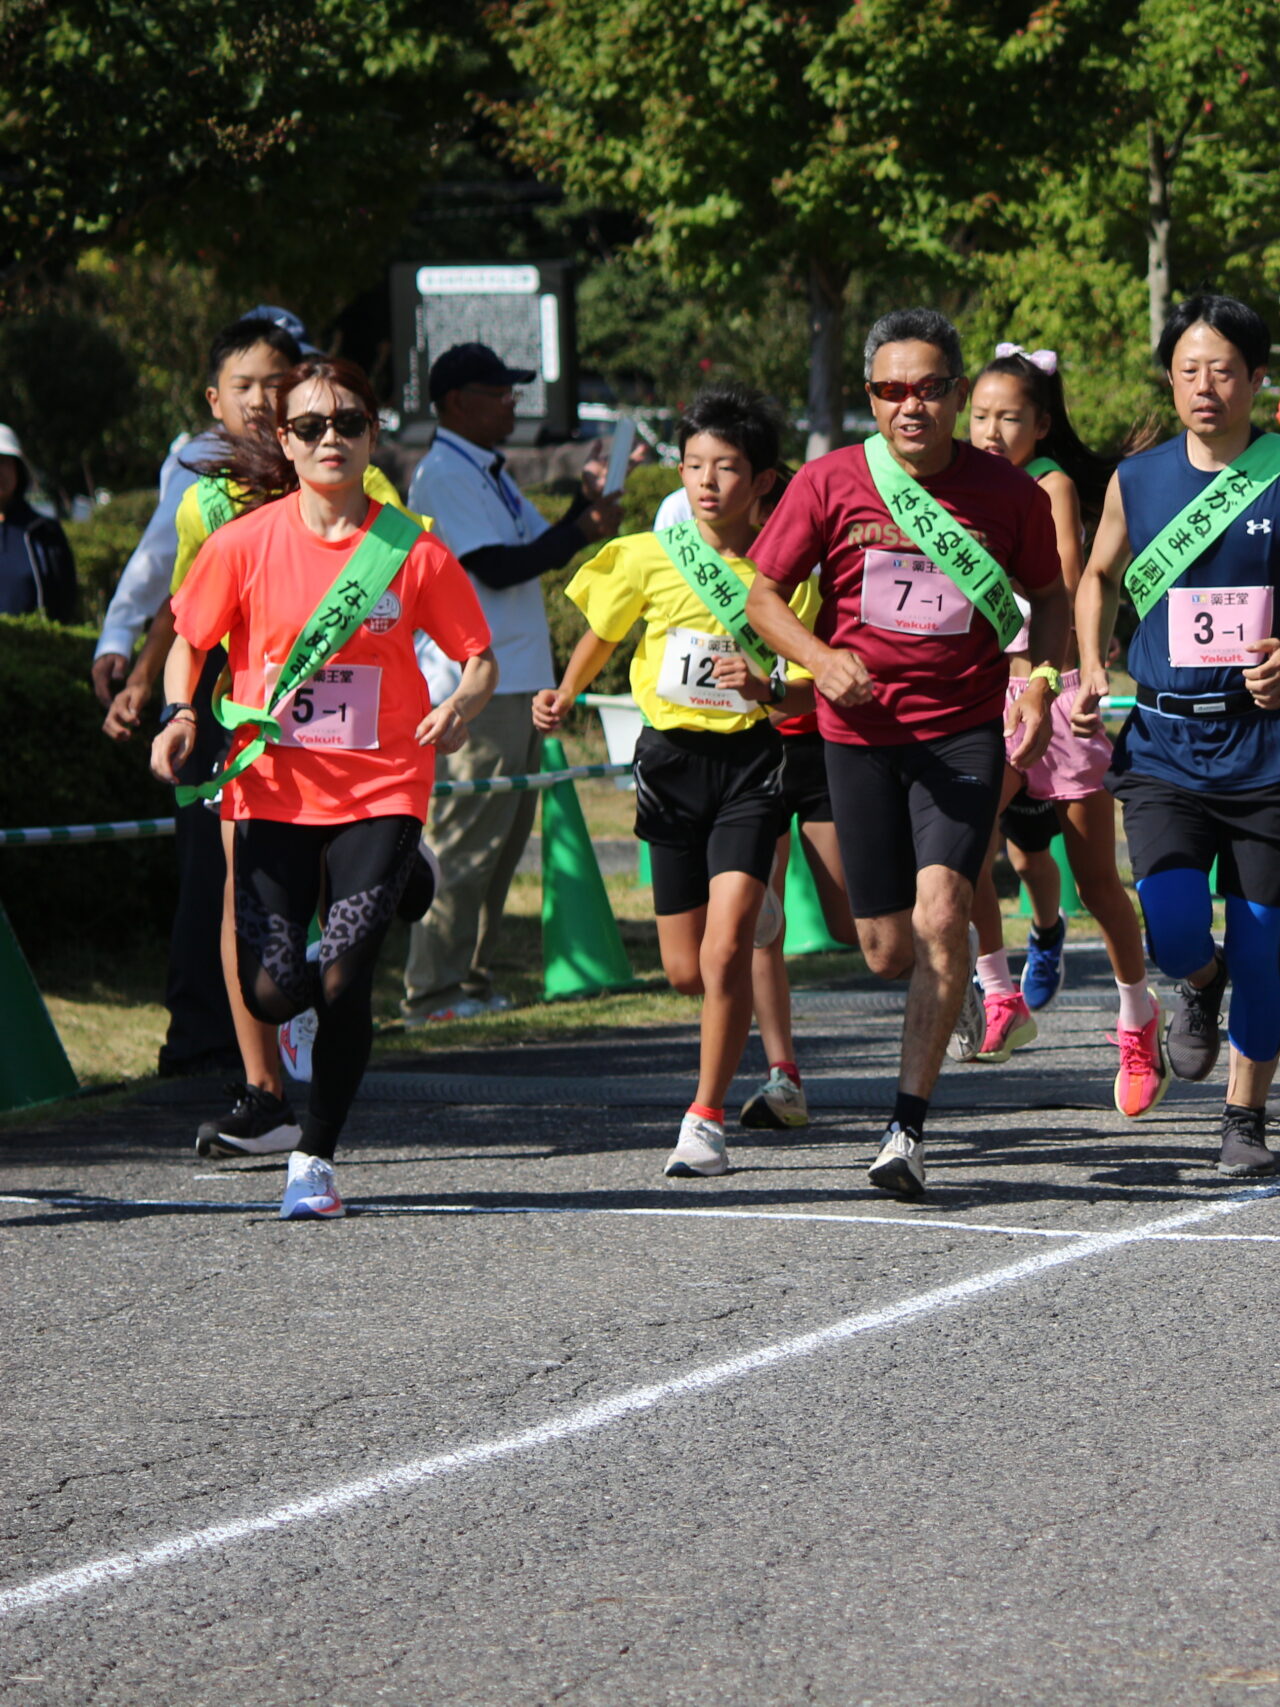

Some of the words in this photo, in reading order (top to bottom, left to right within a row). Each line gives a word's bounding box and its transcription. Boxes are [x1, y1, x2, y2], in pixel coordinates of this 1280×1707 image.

[1210, 592, 1249, 606] 薬王堂
[895, 619, 940, 631] Yakult
[1200, 654, 1245, 663] Yakult
[689, 696, 733, 709] Yakult
[297, 733, 345, 746] Yakult
